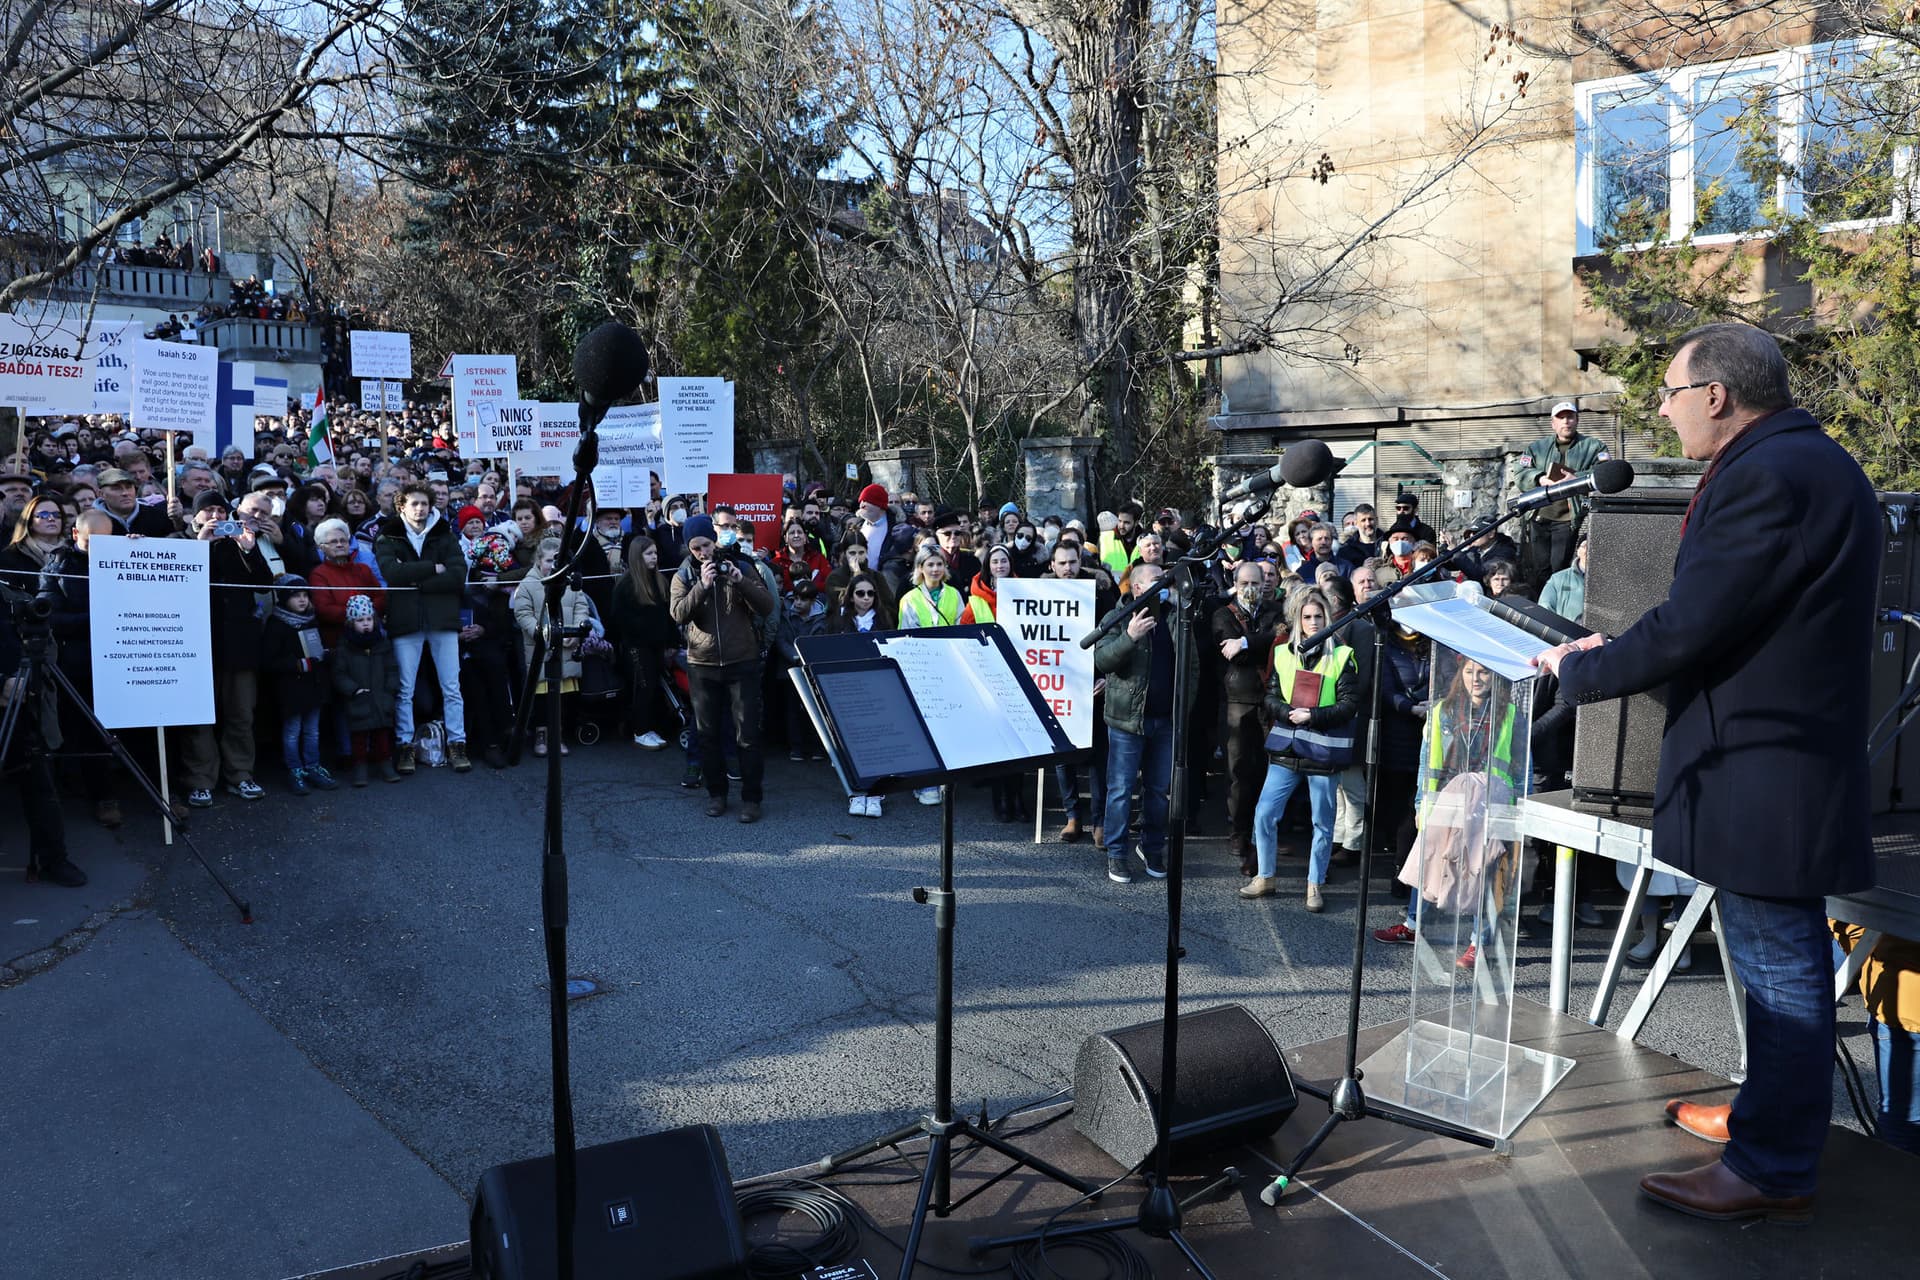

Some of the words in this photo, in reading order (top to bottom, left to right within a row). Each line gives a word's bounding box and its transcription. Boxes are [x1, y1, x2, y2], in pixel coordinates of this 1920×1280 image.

[99, 331, 122, 346] ay,
[12, 343, 69, 359] IGAZSÁG
[158, 349, 180, 359] Isaiah
[182, 352, 197, 360] 5:20
[47, 364, 83, 378] TESZ!
[474, 378, 496, 386] KELL
[471, 388, 503, 397] INKÁBB
[500, 407, 533, 422] NINCS
[491, 424, 532, 437] BILINCSBE
[543, 420, 577, 429] BESZÉDE
[496, 439, 524, 452] VERVE
[540, 440, 563, 448] ERVE!
[734, 503, 775, 511] APOSTOLT
[129, 550, 155, 560] AHOL
[156, 550, 177, 560] MÁR
[98, 560, 149, 570] ELÍTÉLTEK
[150, 562, 203, 572] EMBEREKET
[117, 573, 124, 581] A
[126, 573, 157, 582] BIBLIA
[158, 574, 189, 583] MIATT:
[1012, 598, 1080, 617] TRUTH
[1020, 624, 1071, 642] WILL
[1025, 648, 1065, 667] SET
